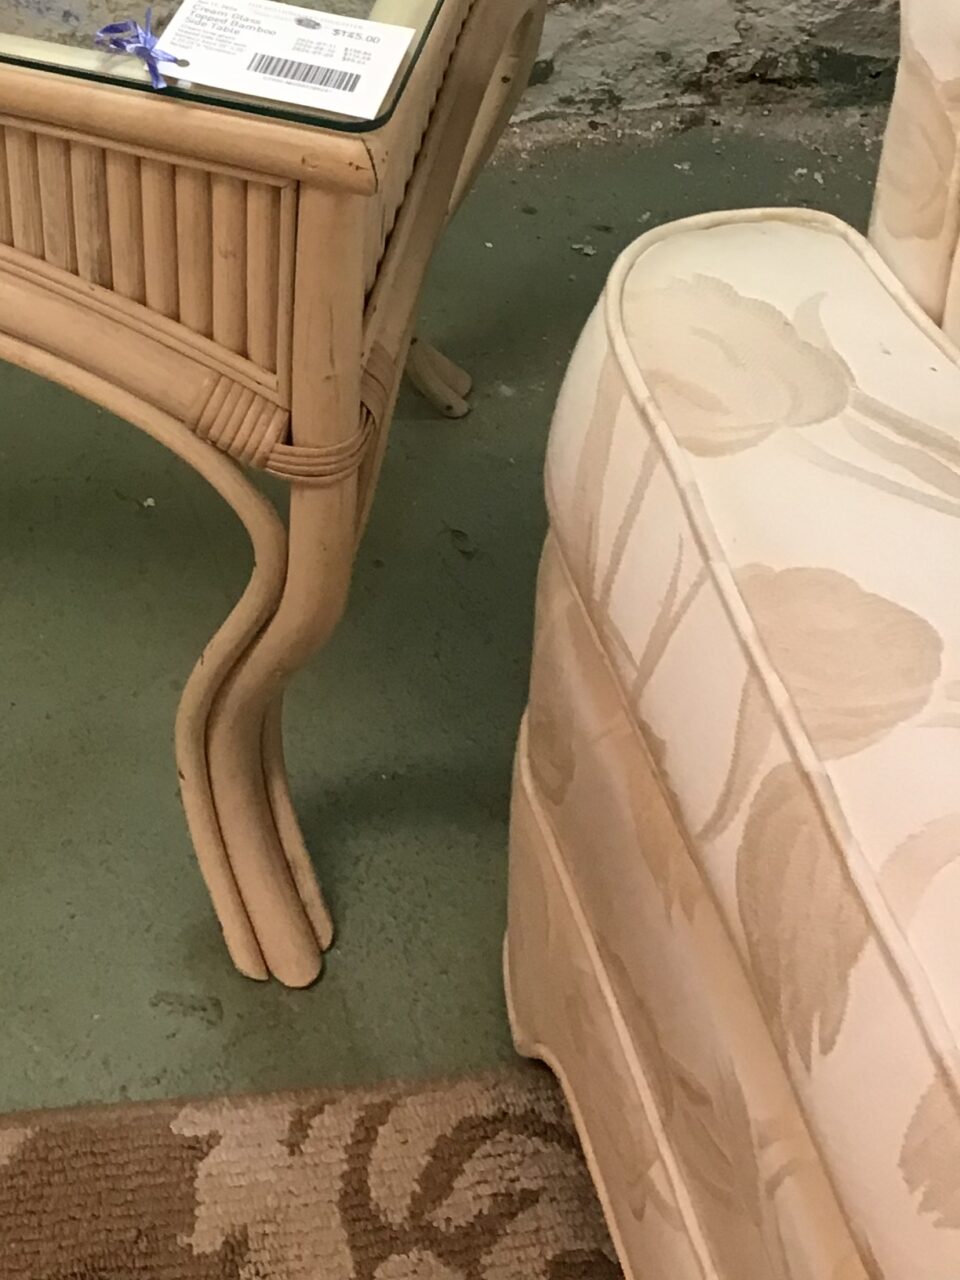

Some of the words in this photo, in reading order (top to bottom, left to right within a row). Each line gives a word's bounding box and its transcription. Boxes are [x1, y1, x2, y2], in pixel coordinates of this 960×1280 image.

[190, 11, 228, 25] Topped
[231, 20, 277, 36] Bamboo
[192, 3, 228, 17] Cream
[231, 13, 261, 25] Glass
[185, 16, 205, 27] Side
[211, 22, 241, 35] Table
